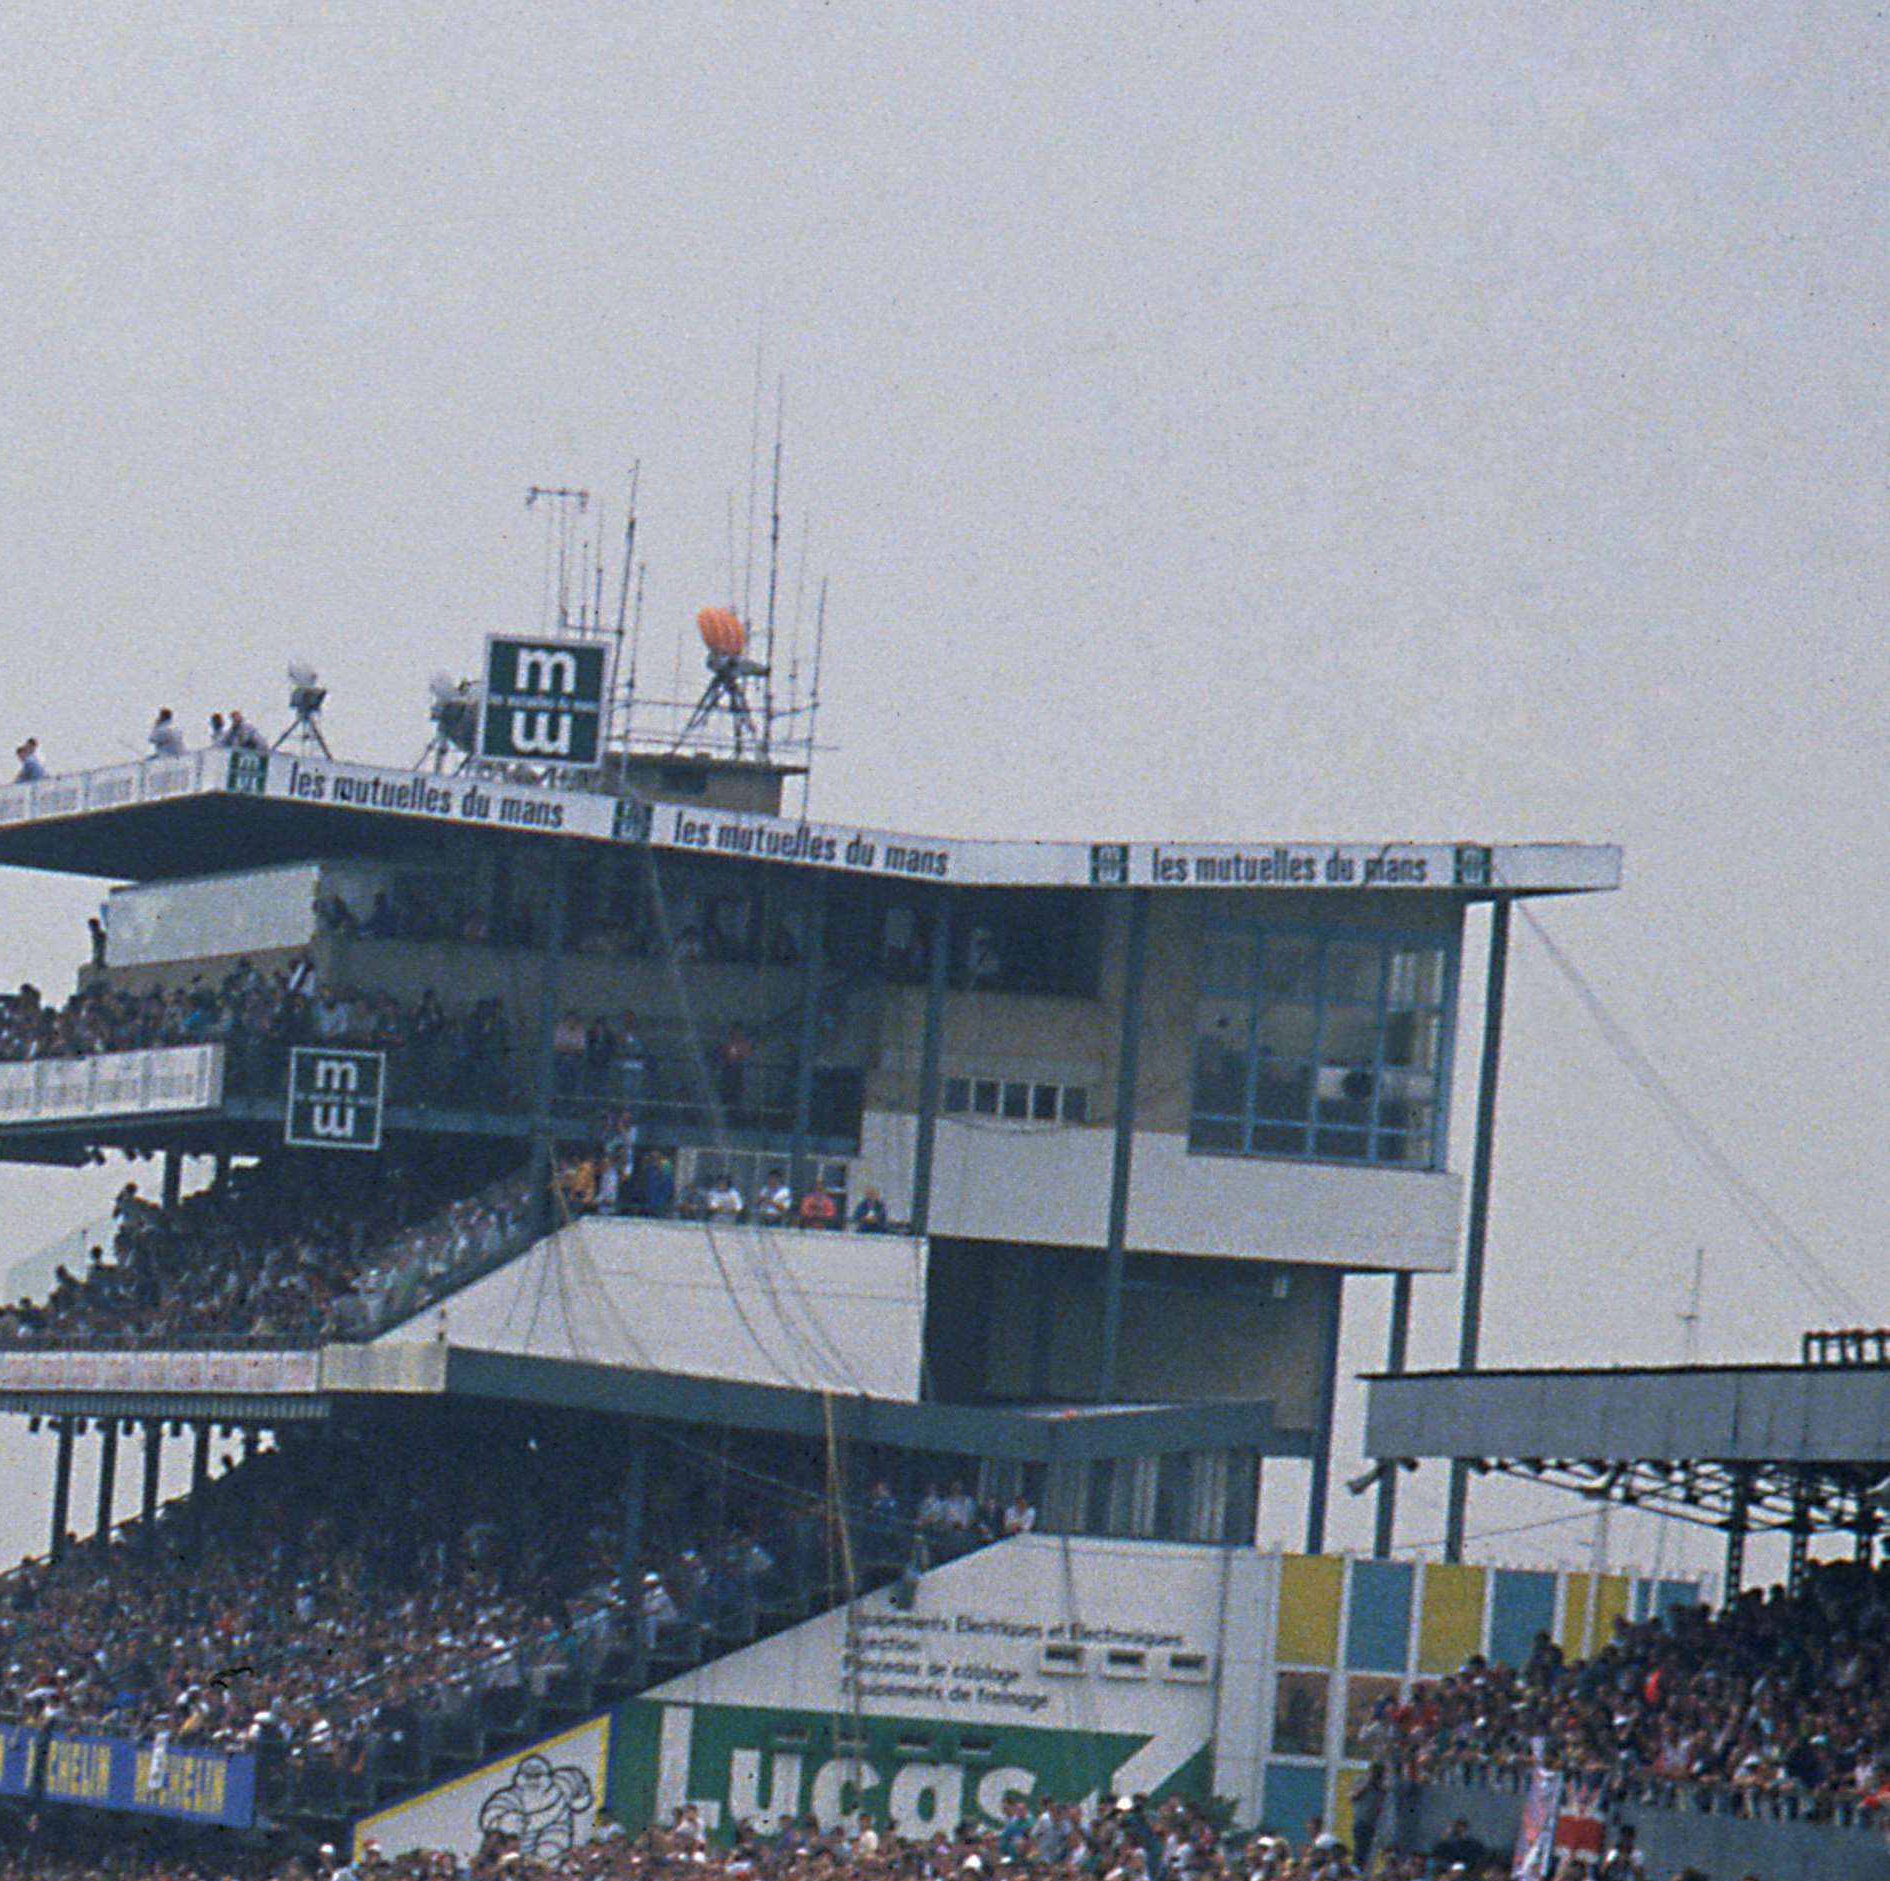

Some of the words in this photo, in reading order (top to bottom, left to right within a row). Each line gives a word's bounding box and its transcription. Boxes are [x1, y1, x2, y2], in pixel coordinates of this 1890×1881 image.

[289, 760, 325, 799] les
[333, 774, 452, 815] mutuelles
[461, 784, 491, 819] du
[499, 795, 564, 829] mans
[673, 809, 710, 848] les
[716, 822, 837, 864] mutuelles
[845, 832, 876, 867] du
[884, 844, 950, 877] mans
[1151, 846, 1188, 883] les
[1195, 847, 1316, 883] mutuelles
[1326, 847, 1355, 883] du
[1365, 855, 1428, 883] mans
[658, 1706, 1040, 1842] Lucas
